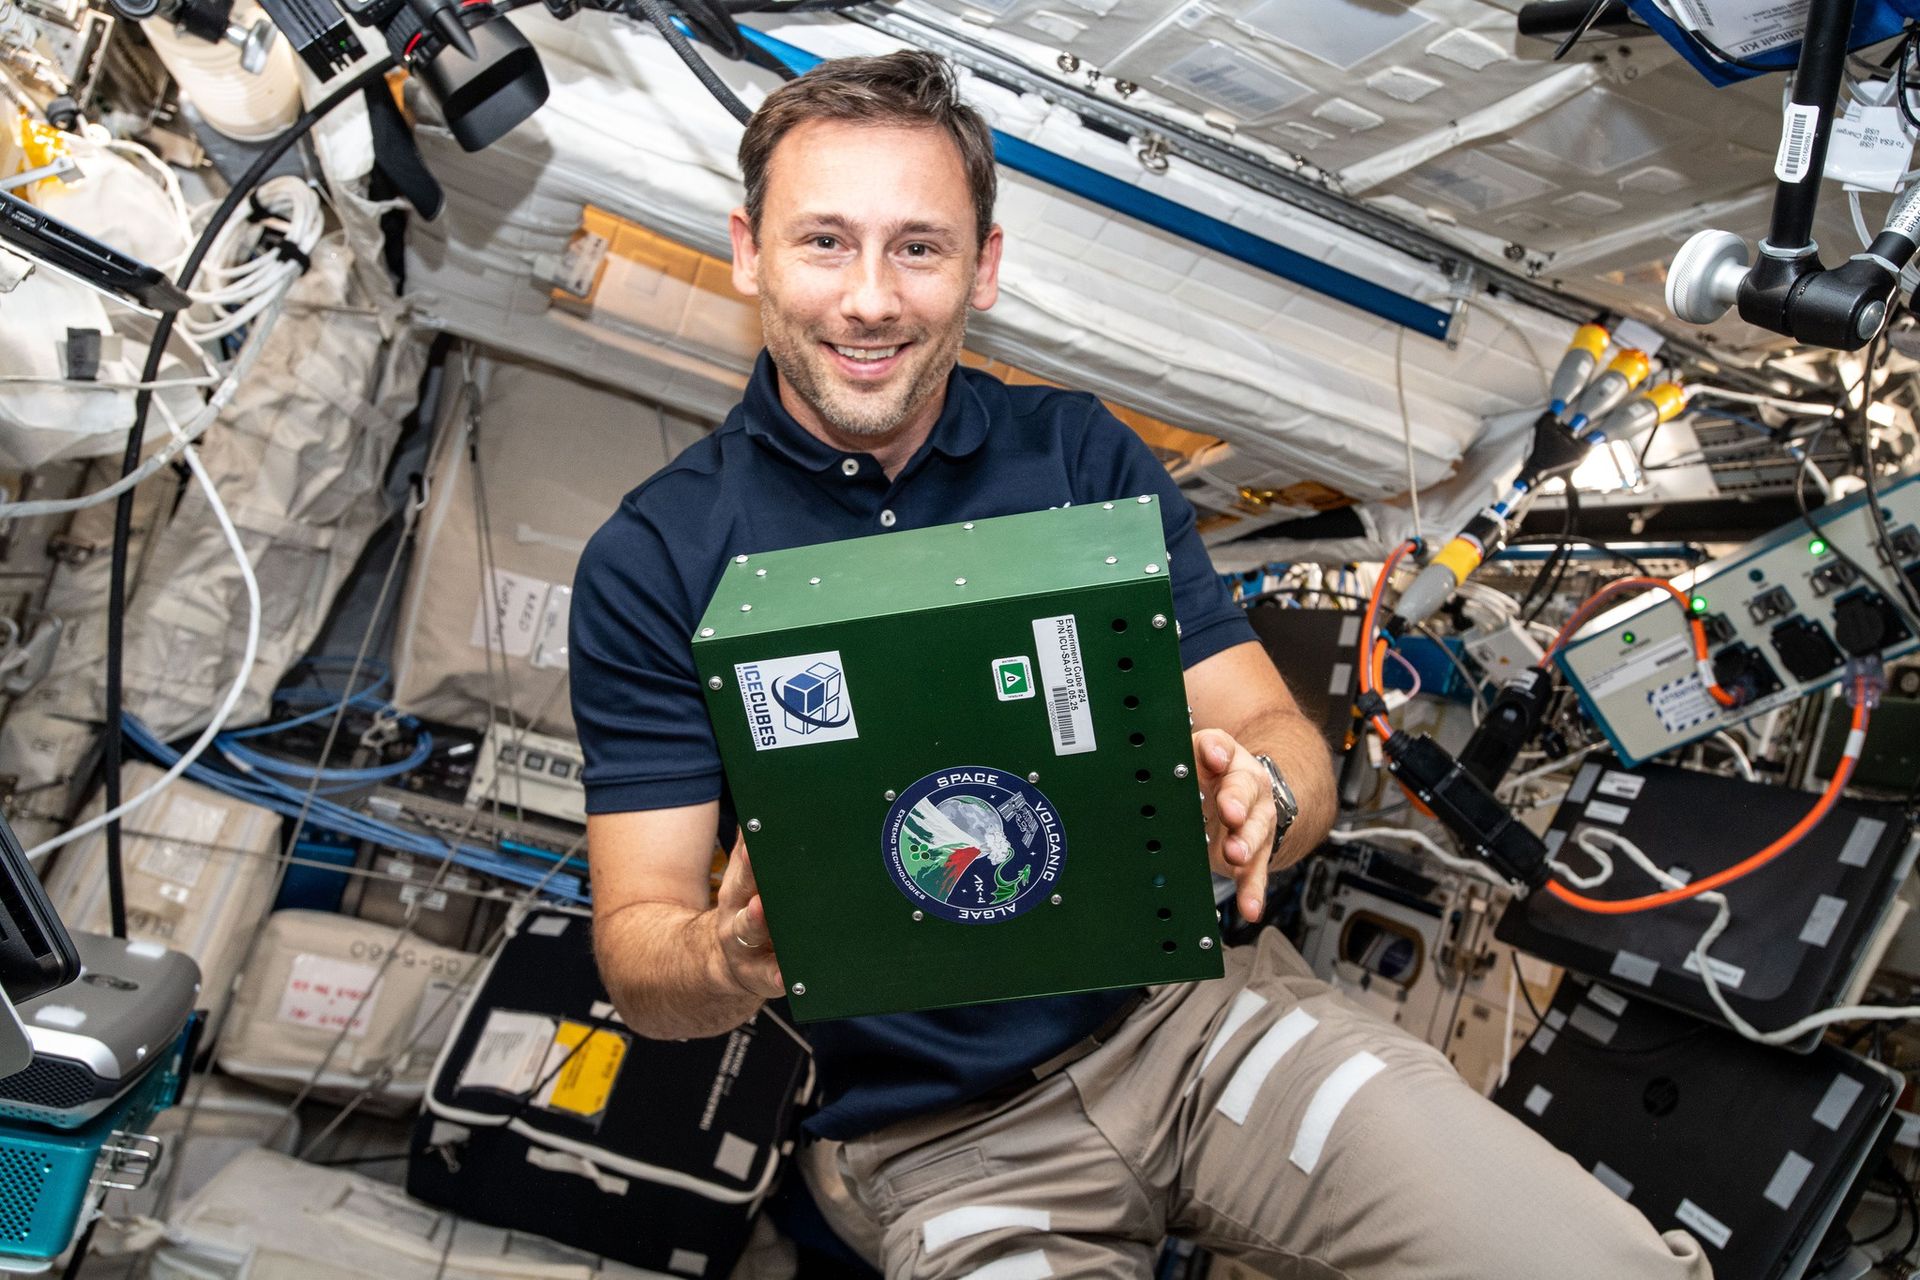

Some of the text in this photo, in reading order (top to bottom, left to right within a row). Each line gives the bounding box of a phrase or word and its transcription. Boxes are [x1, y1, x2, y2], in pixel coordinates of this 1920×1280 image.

[1740, 41, 1759, 53] Kit
[1056, 620, 1078, 711] P/N ICU-SA-01.01.05.25
[1065, 618, 1087, 703] Experiment Cube #24
[743, 665, 777, 746] ICECUBES
[743, 692, 755, 725] APPLICATIONS
[937, 773, 999, 788] SPACE
[890, 809, 926, 900] EXTREMO TECHNOLOGIES
[1035, 801, 1061, 882] VOLCANIC
[958, 902, 1016, 920] ALGAE
